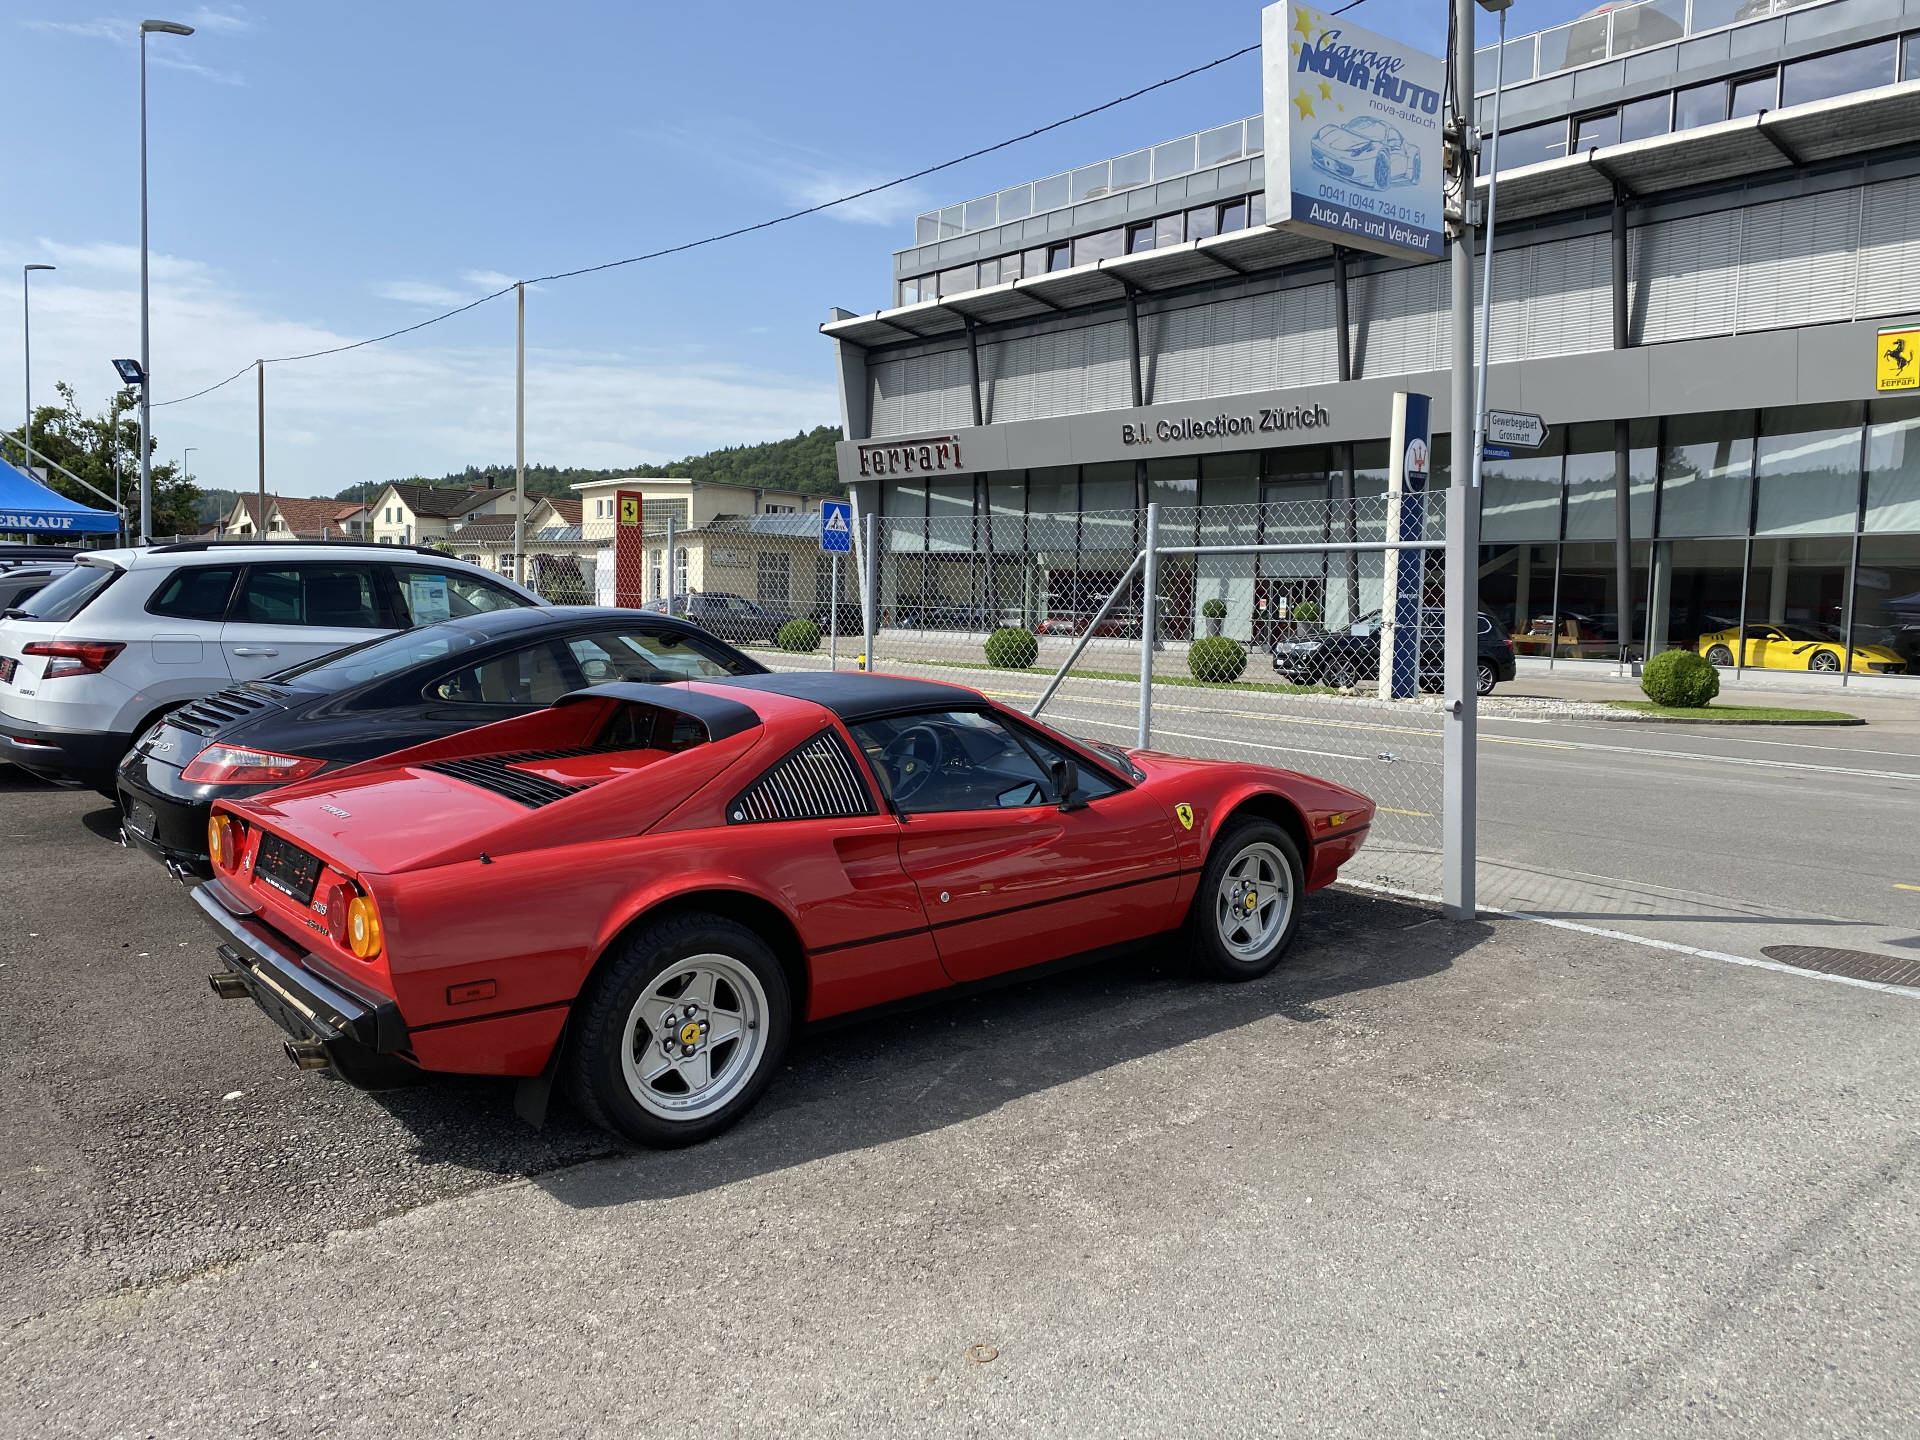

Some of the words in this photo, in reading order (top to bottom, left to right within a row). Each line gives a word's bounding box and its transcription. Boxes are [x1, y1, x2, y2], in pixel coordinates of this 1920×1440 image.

[1316, 29, 1405, 73] Garage
[1297, 42, 1440, 115] NOVA-AUTO
[1369, 99, 1436, 129] nova-auto.ch
[1319, 184, 1345, 202] 0041
[1349, 191, 1375, 210] (0)44
[1378, 201, 1396, 216] 734
[1398, 207, 1411, 220] 01
[1414, 212, 1426, 224] 51
[1309, 202, 1339, 225] Auto
[1342, 212, 1362, 231] An-
[1365, 221, 1385, 237] und
[1389, 224, 1430, 249] Verkauf
[1881, 377, 1915, 387] Ferrari
[1156, 413, 1254, 442] Collection
[1259, 403, 1329, 432] Zürich
[1492, 414, 1538, 430] Gewerbegebiet
[1498, 430, 1530, 442] Grossmatt
[858, 434, 963, 476] Ferrari
